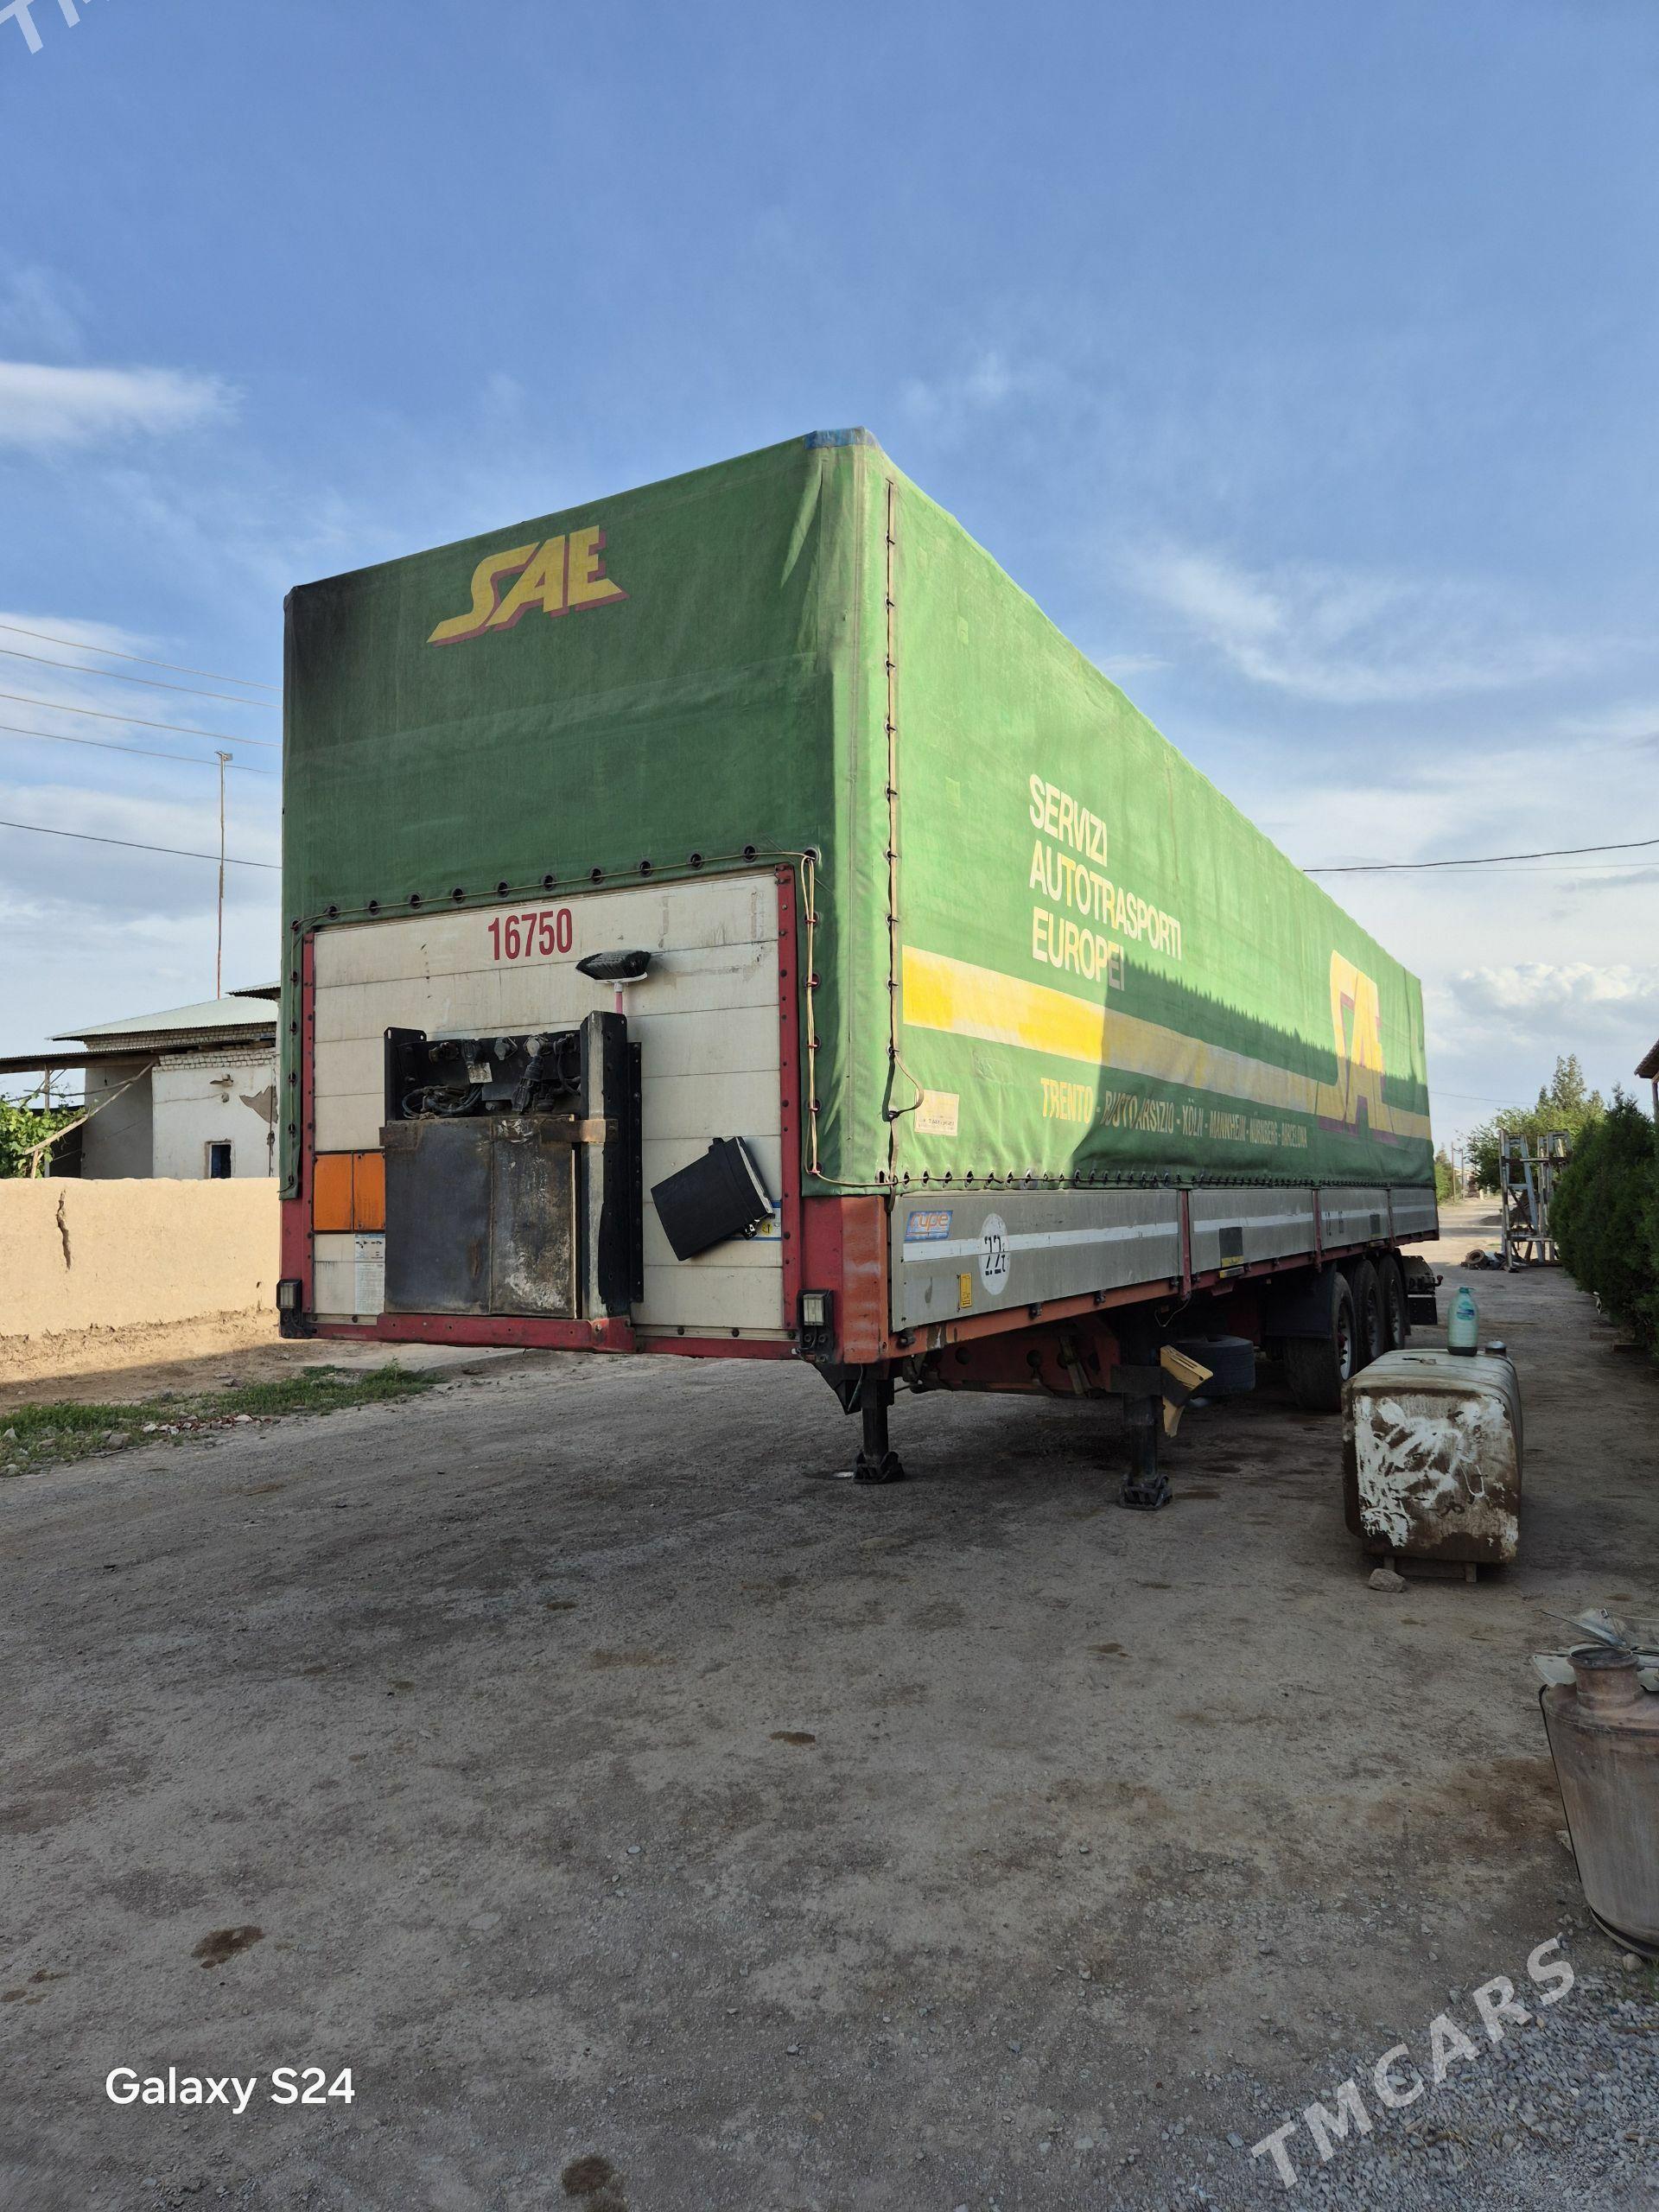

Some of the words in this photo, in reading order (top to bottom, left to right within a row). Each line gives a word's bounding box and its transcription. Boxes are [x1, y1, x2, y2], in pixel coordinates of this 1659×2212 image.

[425, 524, 630, 647] SAE
[1029, 773, 1108, 866] SERVIZI
[488, 908, 573, 961] 16750
[1030, 840, 1181, 961] AUTOTRASPORTI
[1033, 906, 1125, 991] EUROPEI
[1040, 1077, 1093, 1124] TRENTO
[1100, 1090, 1138, 1128] BUSTO
[1135, 1098, 1174, 1135] ARSIZIO
[1210, 1110, 1246, 1141] MANNHEIM
